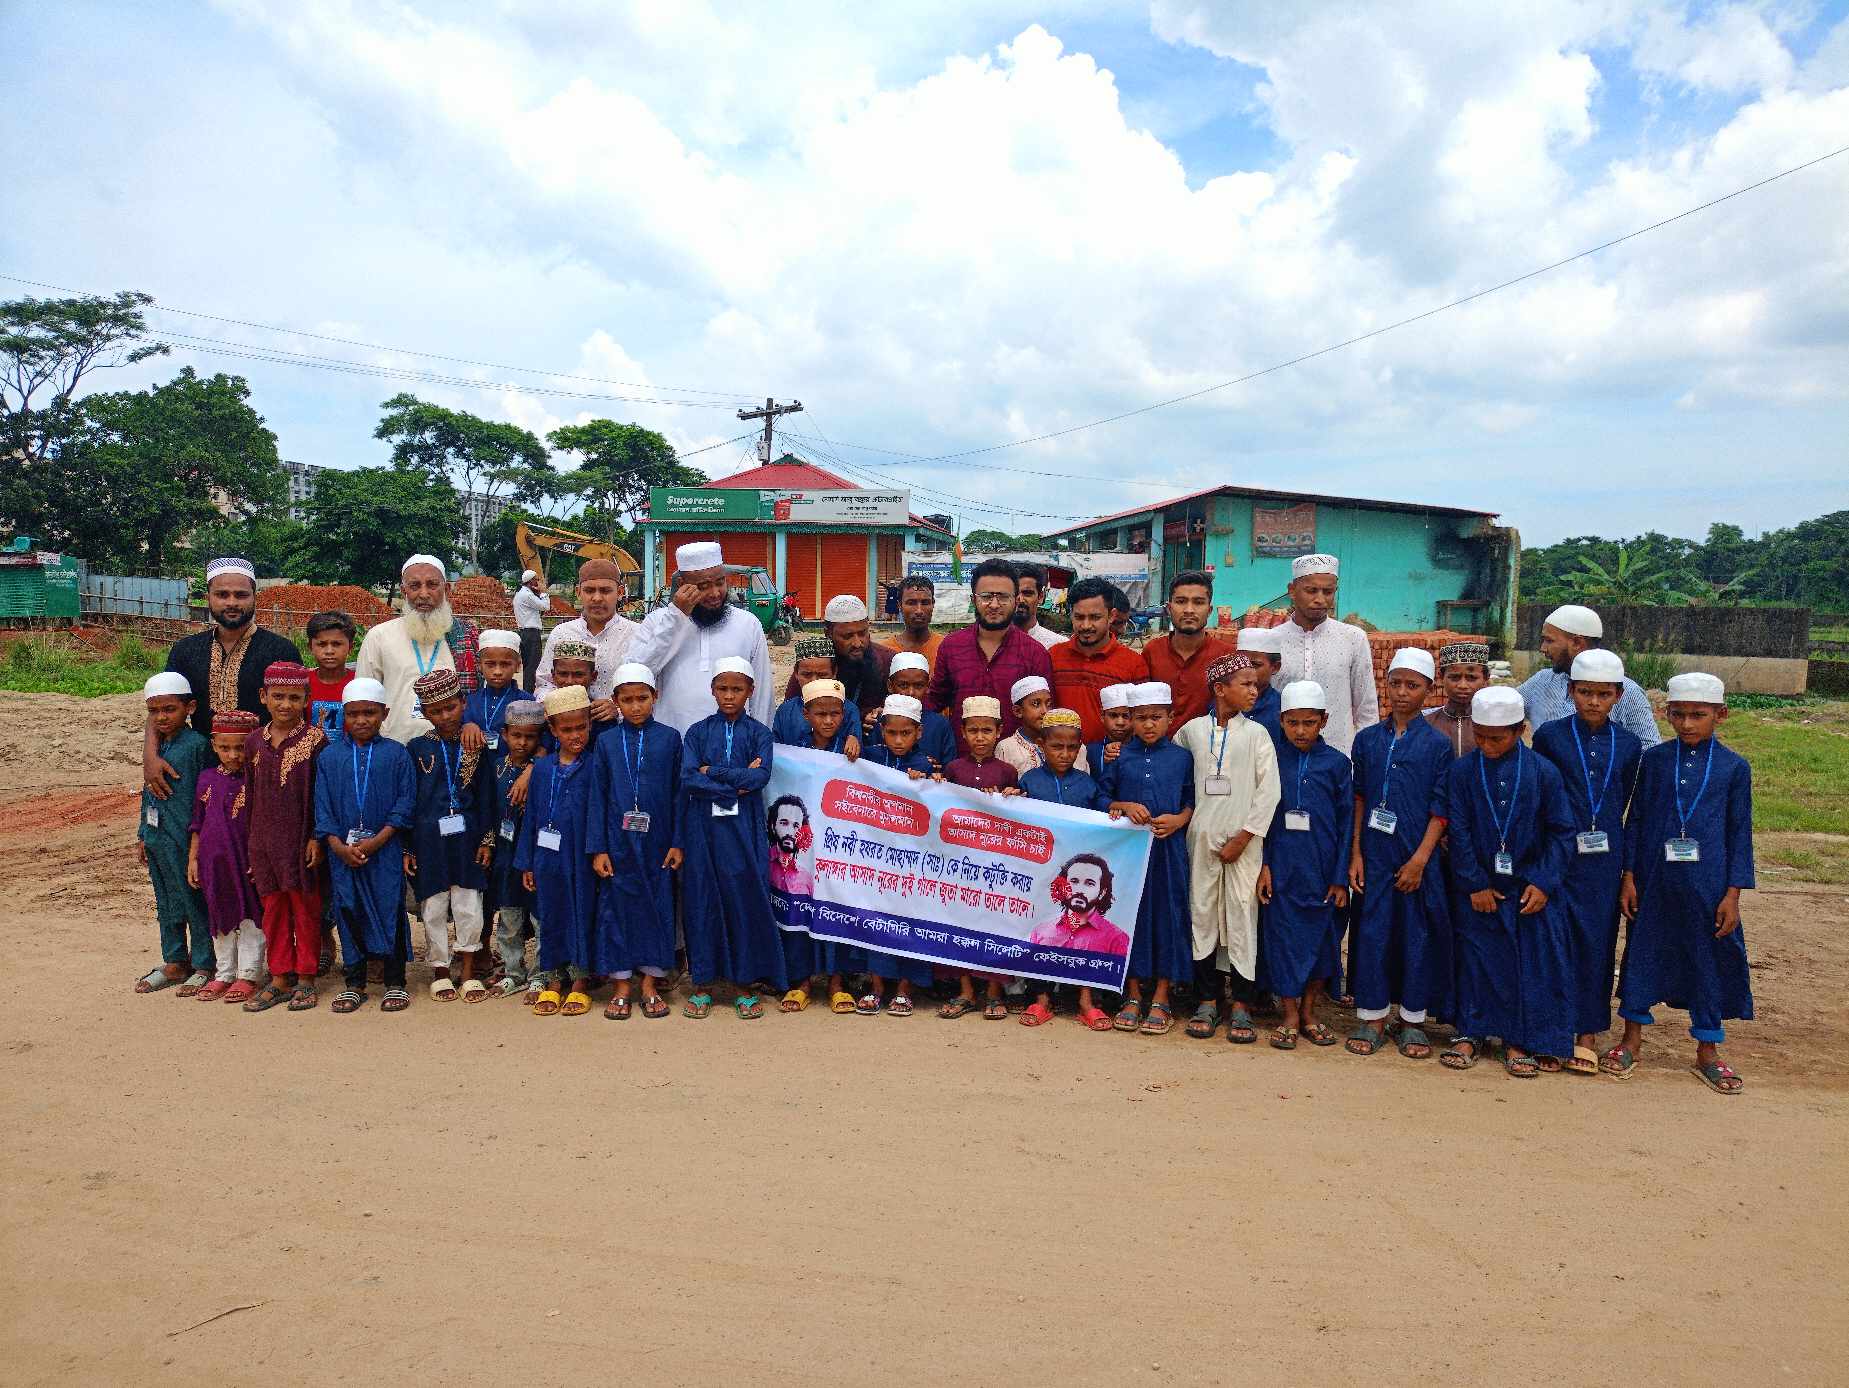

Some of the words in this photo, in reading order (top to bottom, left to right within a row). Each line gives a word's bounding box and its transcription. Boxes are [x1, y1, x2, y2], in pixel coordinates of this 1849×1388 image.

[666, 495, 725, 507] Supercrete
[952, 815, 992, 830] আমাদের
[841, 830, 859, 857] নবী
[859, 839, 884, 860] হযরত
[946, 858, 961, 876] কে
[961, 855, 981, 881] নিয়ে
[849, 863, 877, 888] আসাদ
[901, 873, 916, 899] দুই
[917, 874, 938, 899] গালে
[984, 892, 1006, 914] তালে
[818, 905, 861, 927] বিদেশে
[862, 917, 912, 937] বেটাগিরি
[913, 927, 950, 944] আমরা
[1033, 951, 1088, 969] ফেইসবুক
